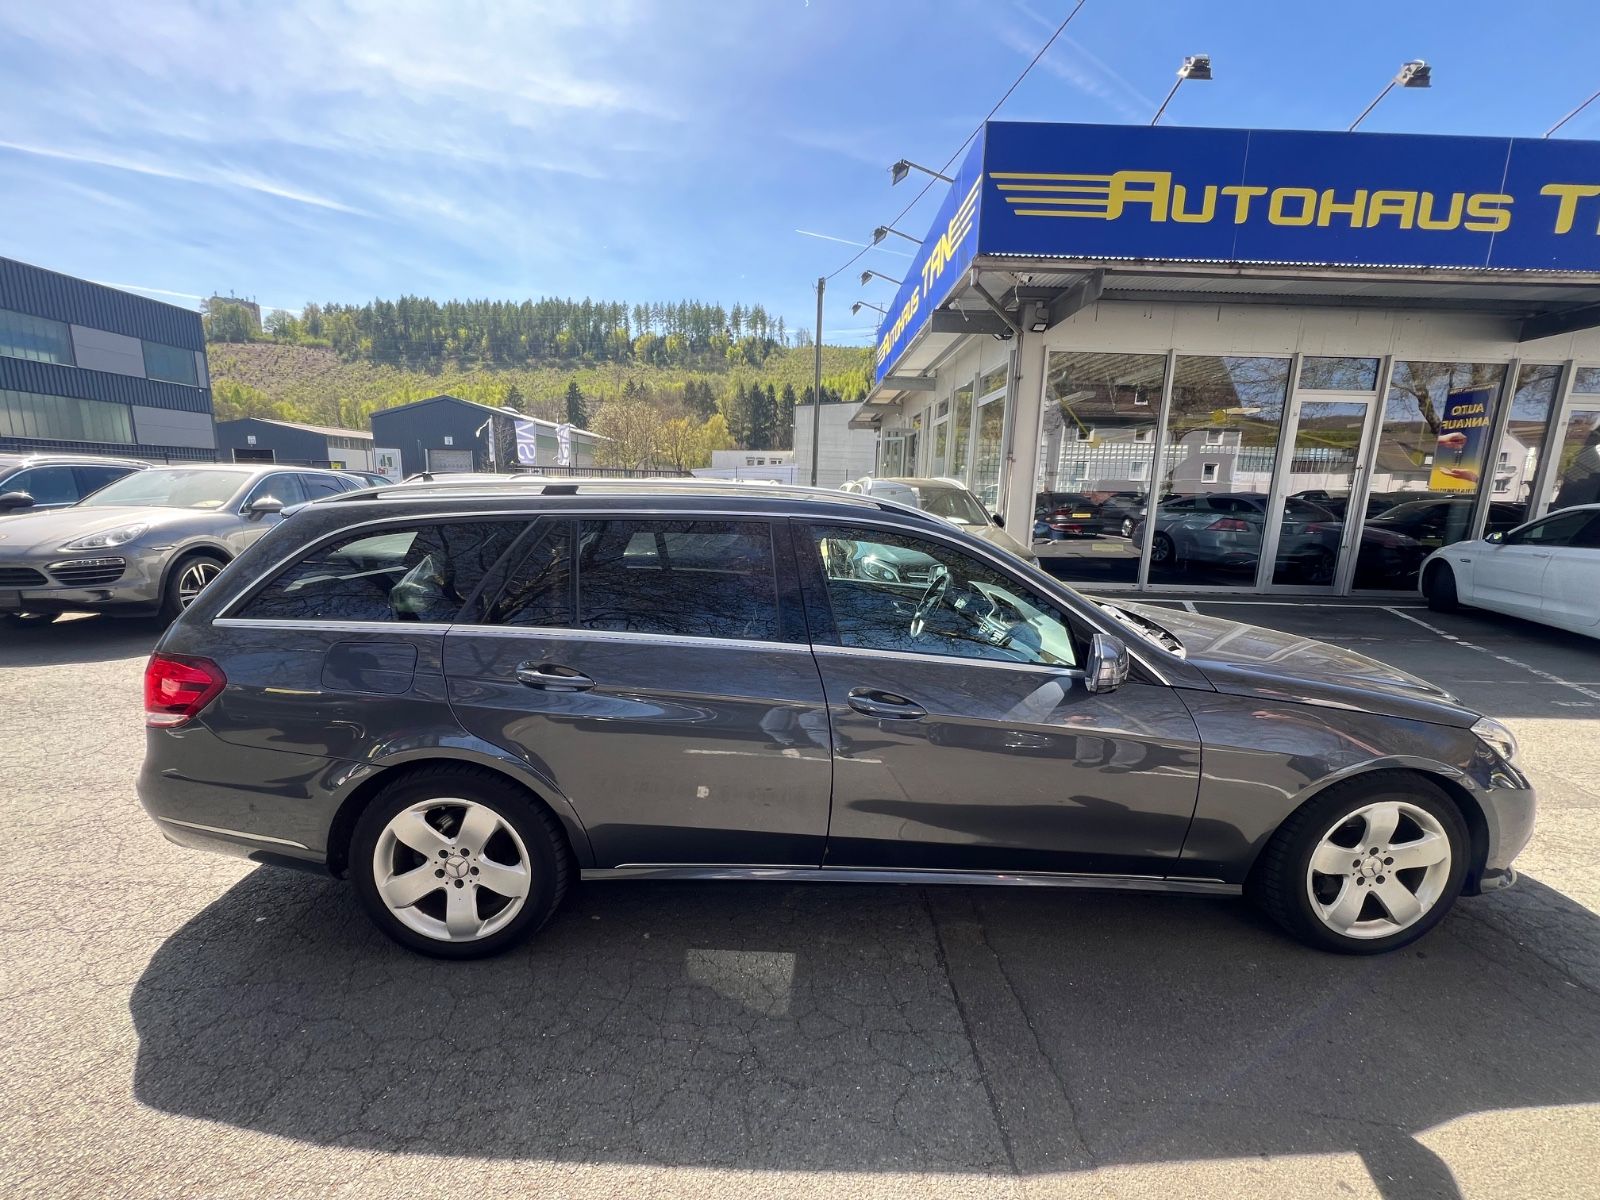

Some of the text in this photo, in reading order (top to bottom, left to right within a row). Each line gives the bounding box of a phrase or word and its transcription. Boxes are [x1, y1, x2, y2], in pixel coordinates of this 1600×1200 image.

[1106, 170, 1600, 236] AUTOHAUS T
[883, 285, 920, 356] AUTOHAUS
